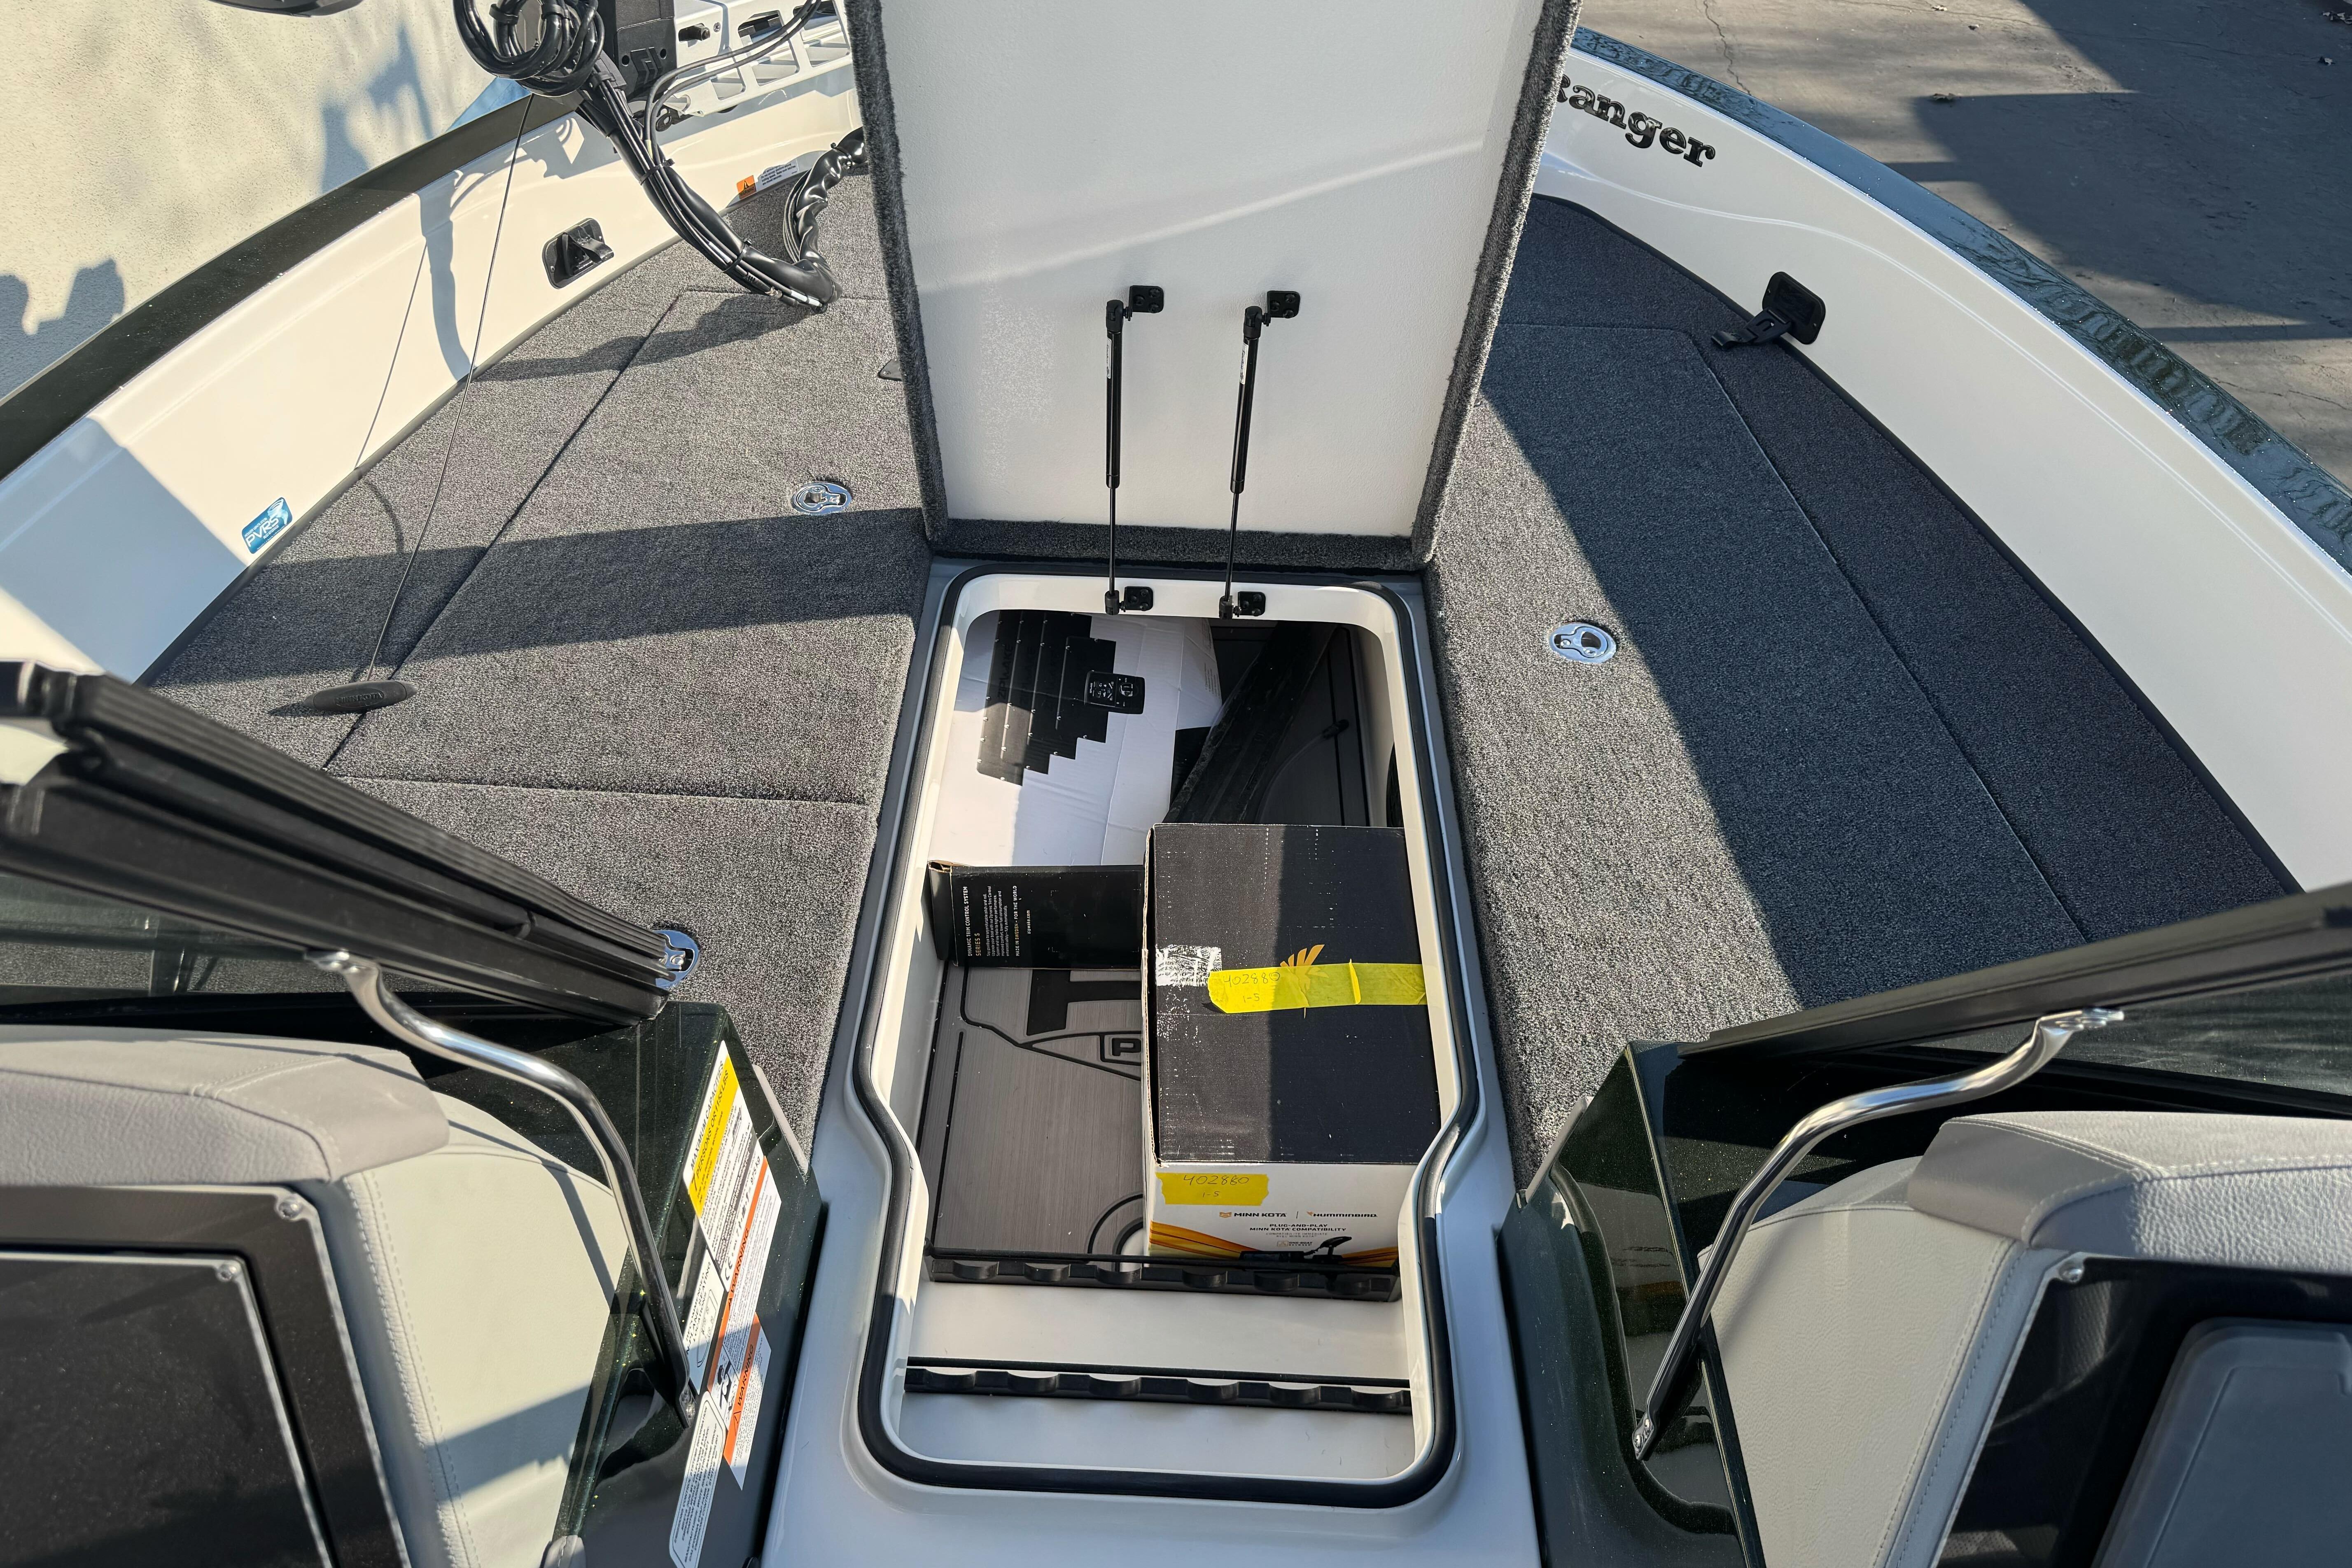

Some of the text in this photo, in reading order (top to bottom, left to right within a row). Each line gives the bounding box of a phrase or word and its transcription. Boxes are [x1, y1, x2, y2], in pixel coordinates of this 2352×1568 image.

[245, 518, 279, 547] PVRS
[1223, 972, 1280, 987] 402880
[691, 1061, 723, 1171] MAXIMUM CAPACITIES
[692, 1173, 698, 1193] 7
[696, 1127, 712, 1179] PERSONS
[710, 1111, 716, 1128] OR
[698, 1261, 711, 1305] SEATING
[731, 1229, 749, 1293] WARNING
[738, 1344, 754, 1406] WARNING
